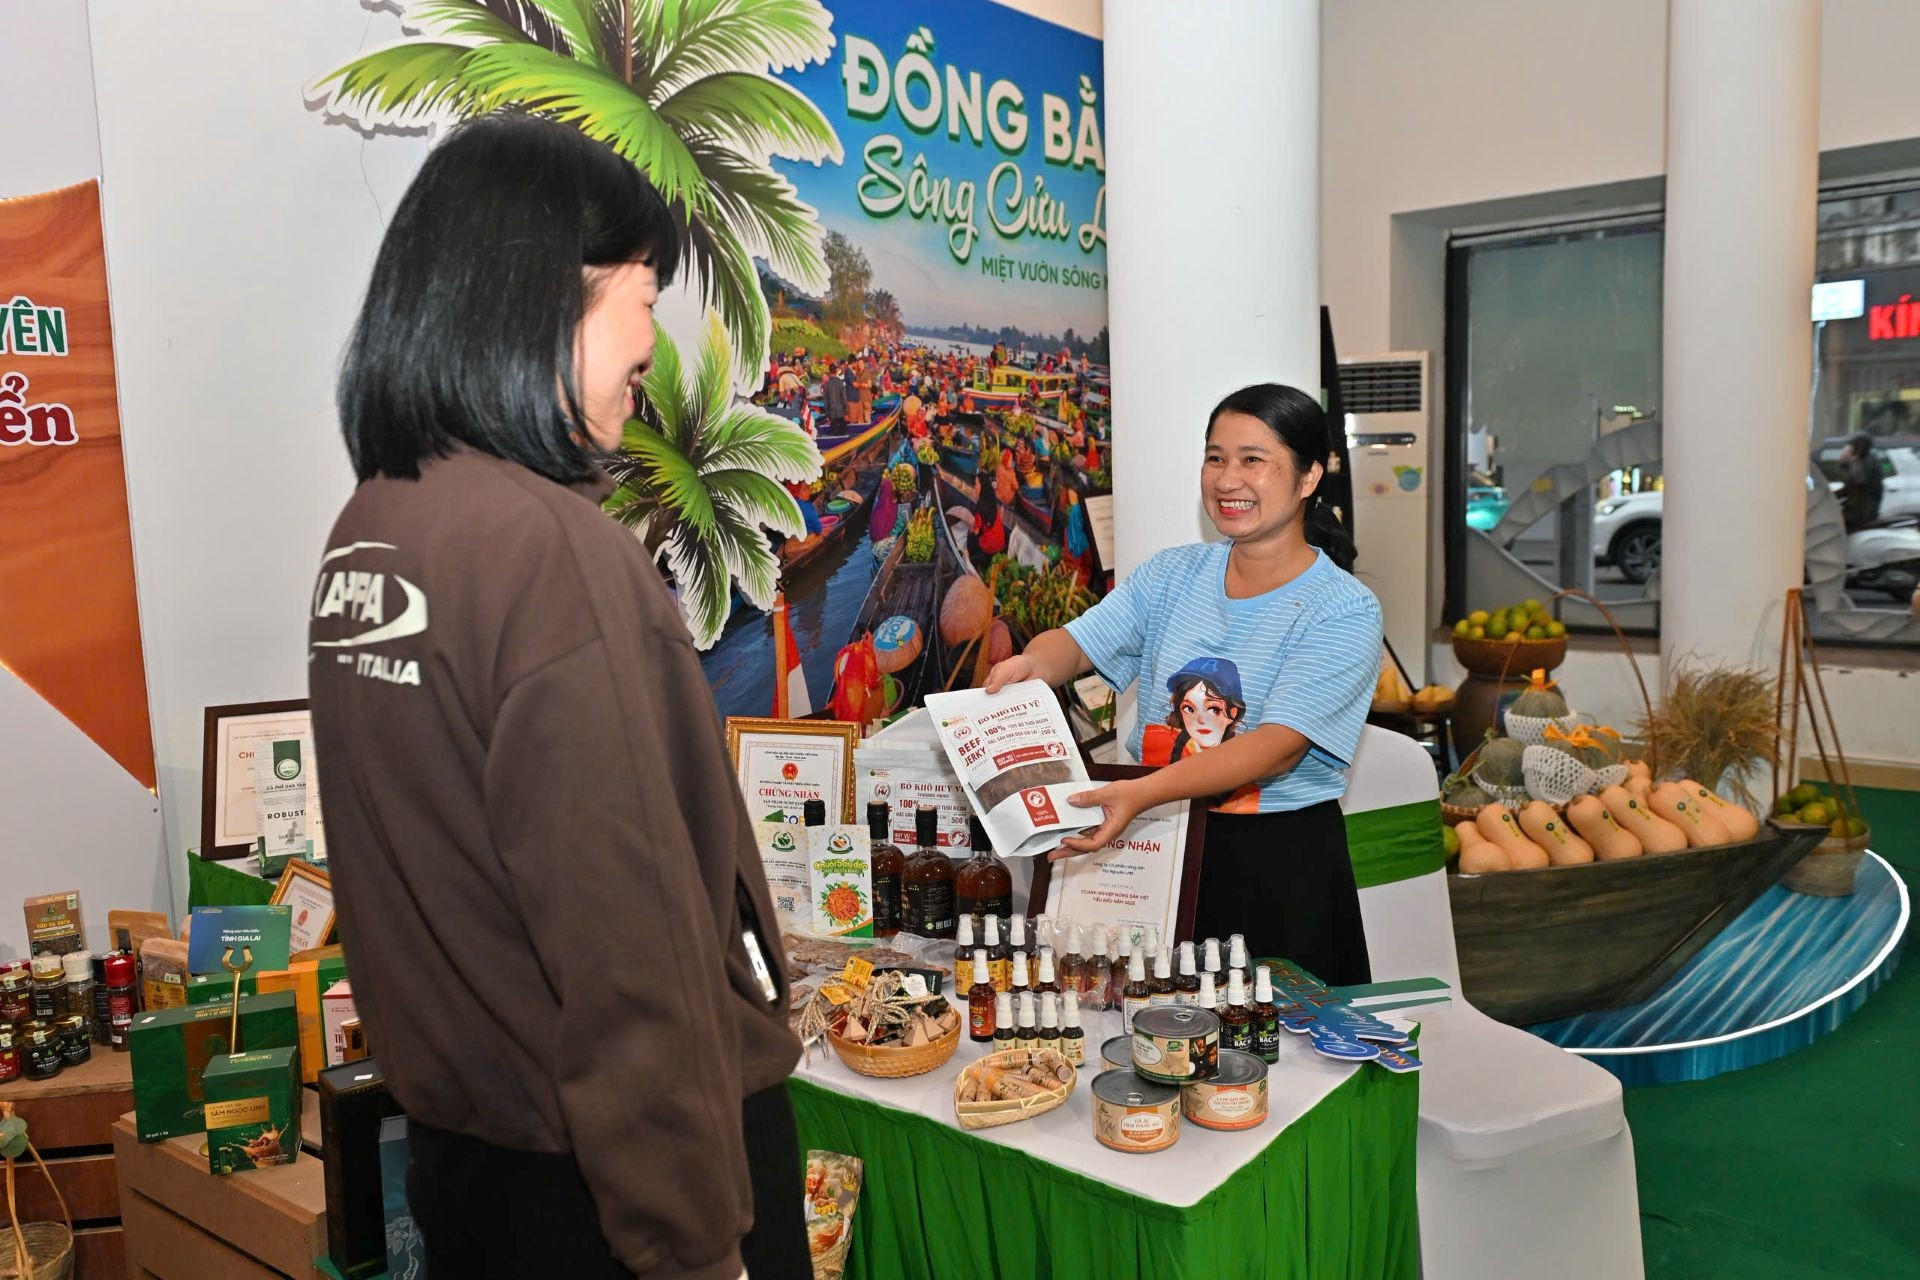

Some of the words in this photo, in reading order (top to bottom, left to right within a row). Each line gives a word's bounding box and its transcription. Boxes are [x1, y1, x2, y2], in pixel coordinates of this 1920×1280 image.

[842, 26, 1029, 154] ĐỒNG
[857, 134, 978, 263] Sông
[986, 162, 1070, 236] Cửu
[981, 256, 1013, 282] MIỆT
[1018, 262, 1058, 285] VƯỜN
[1062, 267, 1100, 290] SÔNG
[316, 571, 384, 624] APPA
[357, 653, 421, 685] ITALIA
[1010, 703, 1027, 714] HUY
[984, 725, 1006, 737] 100%
[958, 736, 981, 757] BEEF
[964, 746, 986, 767] JERKY
[759, 787, 792, 798] CHỨNG
[914, 783, 932, 792] KHÔ
[935, 784, 952, 792] HUY
[899, 799, 920, 809] 100%
[951, 816, 963, 824] 500
[1034, 814, 1055, 822] NATURAL
[1128, 840, 1160, 855] NHẬN
